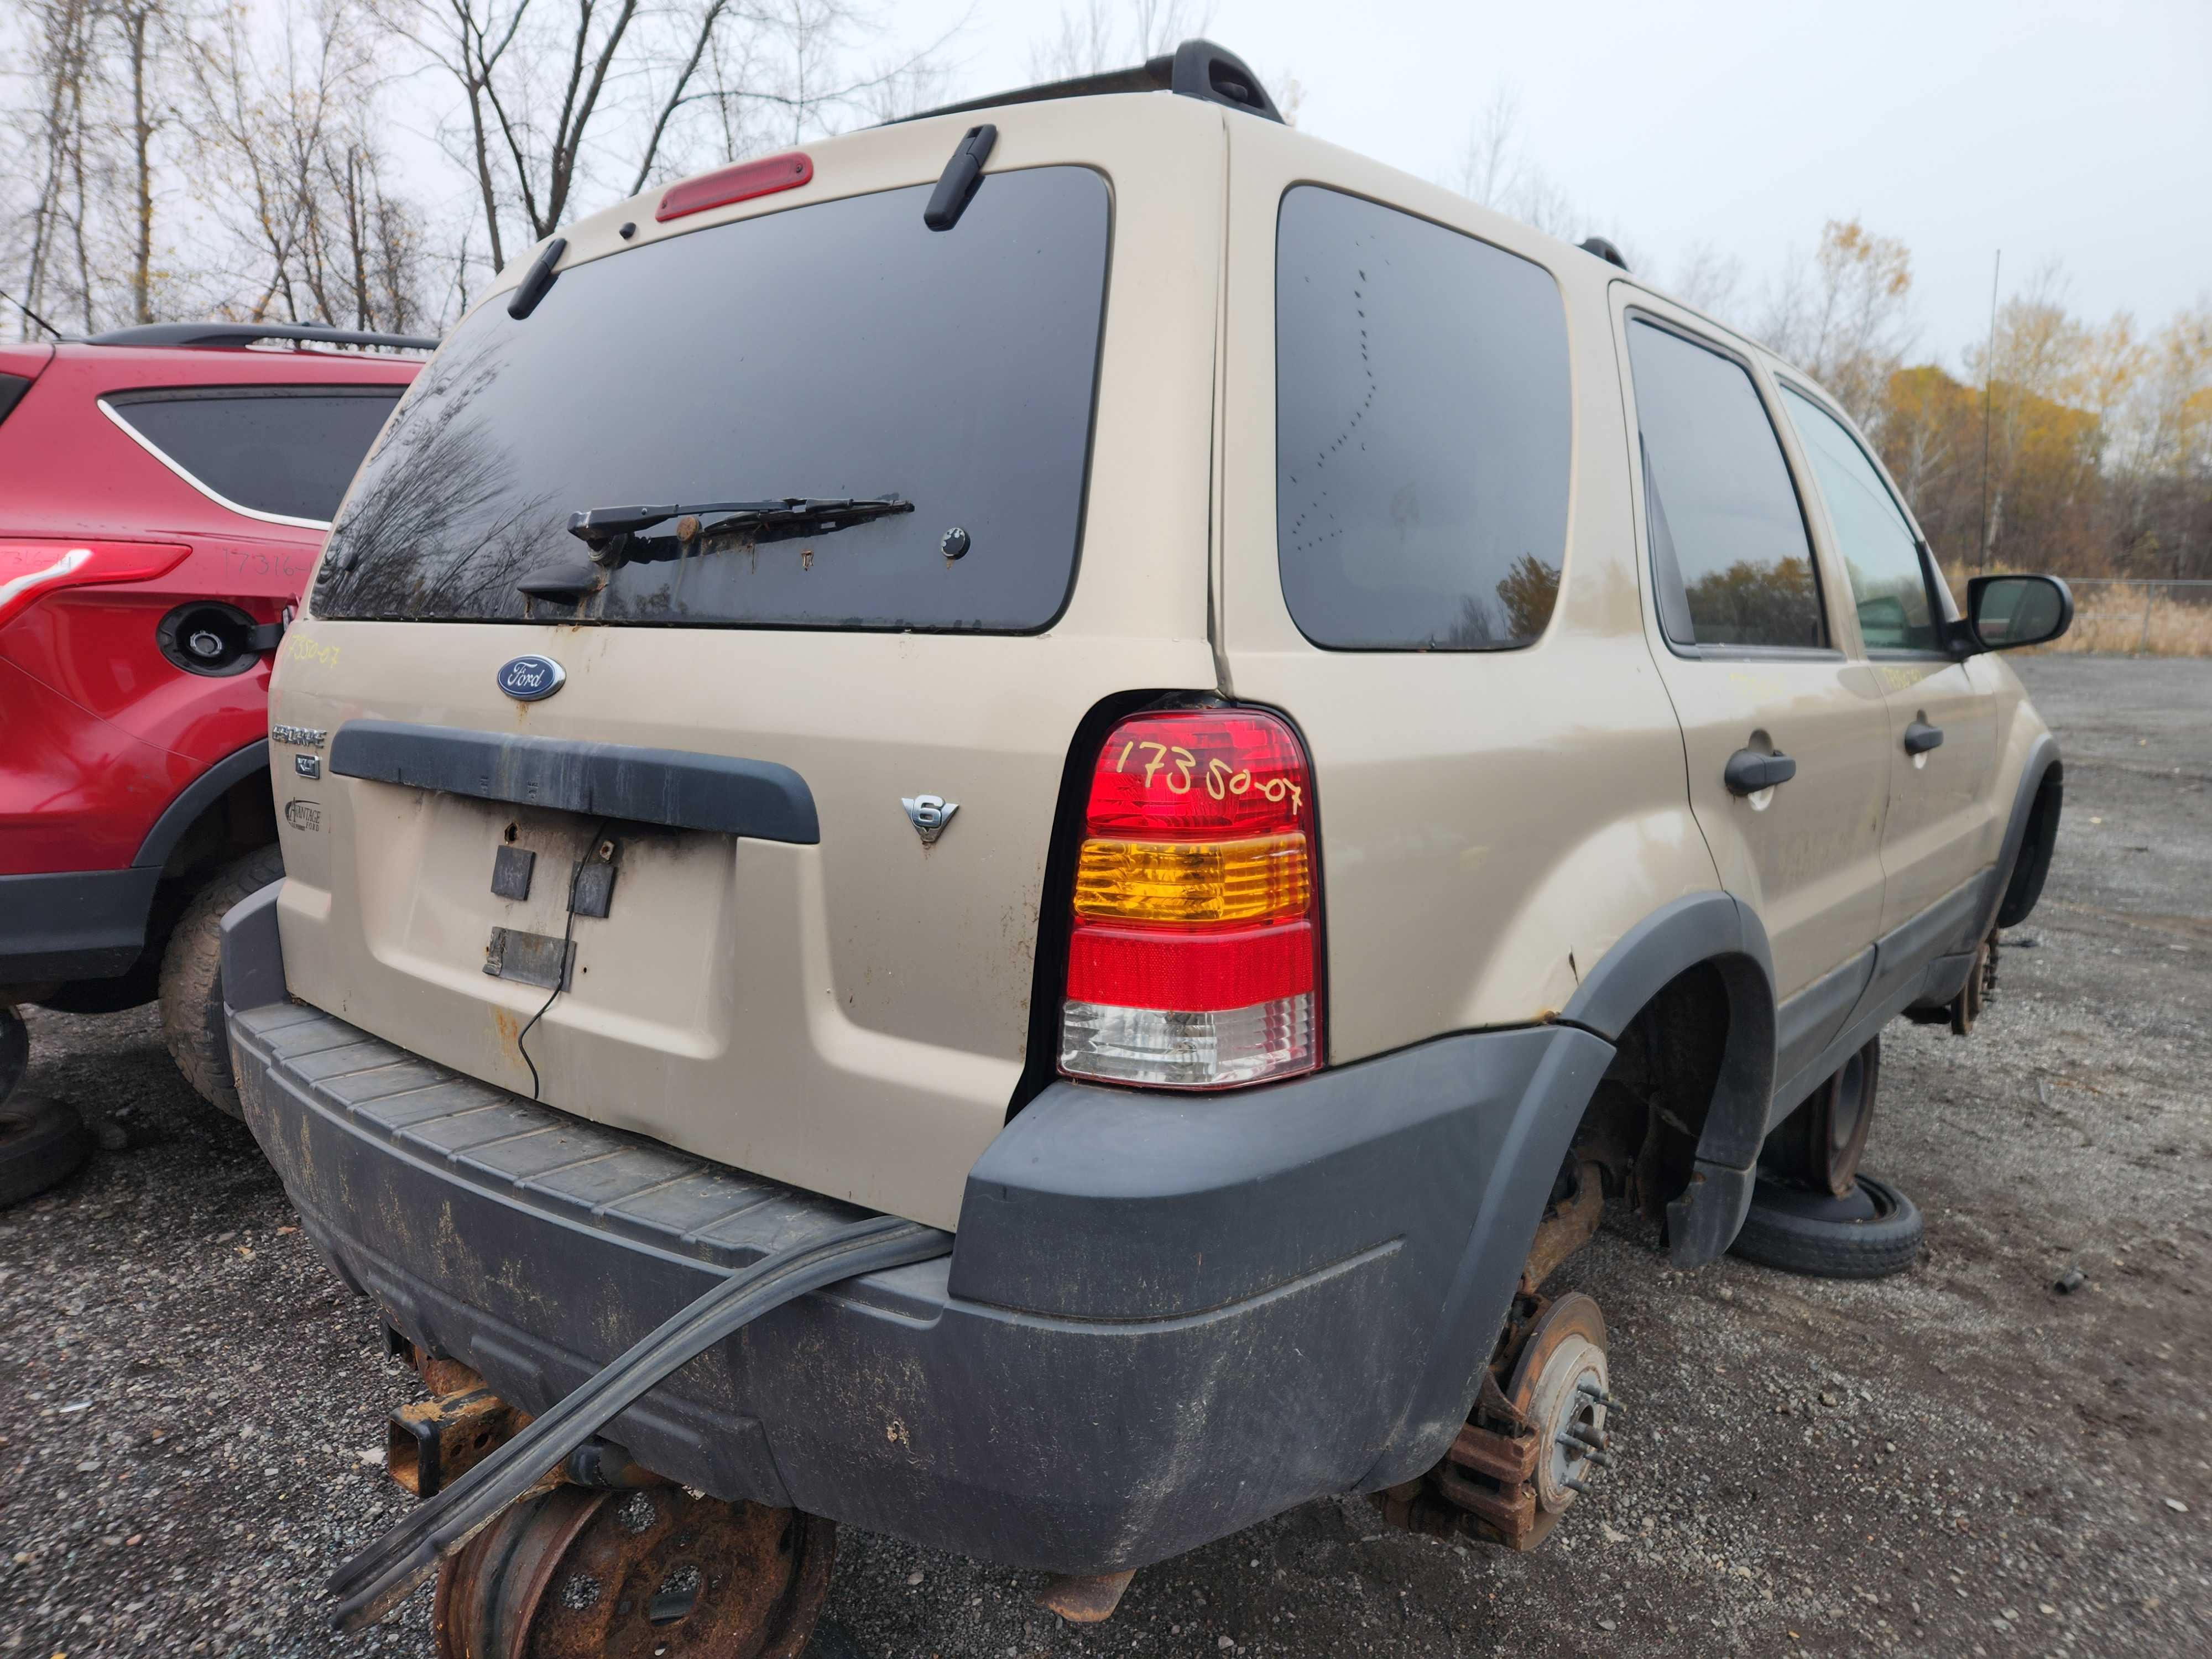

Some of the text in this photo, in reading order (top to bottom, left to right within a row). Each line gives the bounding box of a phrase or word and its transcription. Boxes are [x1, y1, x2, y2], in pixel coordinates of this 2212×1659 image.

[507, 661, 545, 687] Ford
[272, 723, 327, 749] ESCAPE
[305, 821, 320, 832] FORD
